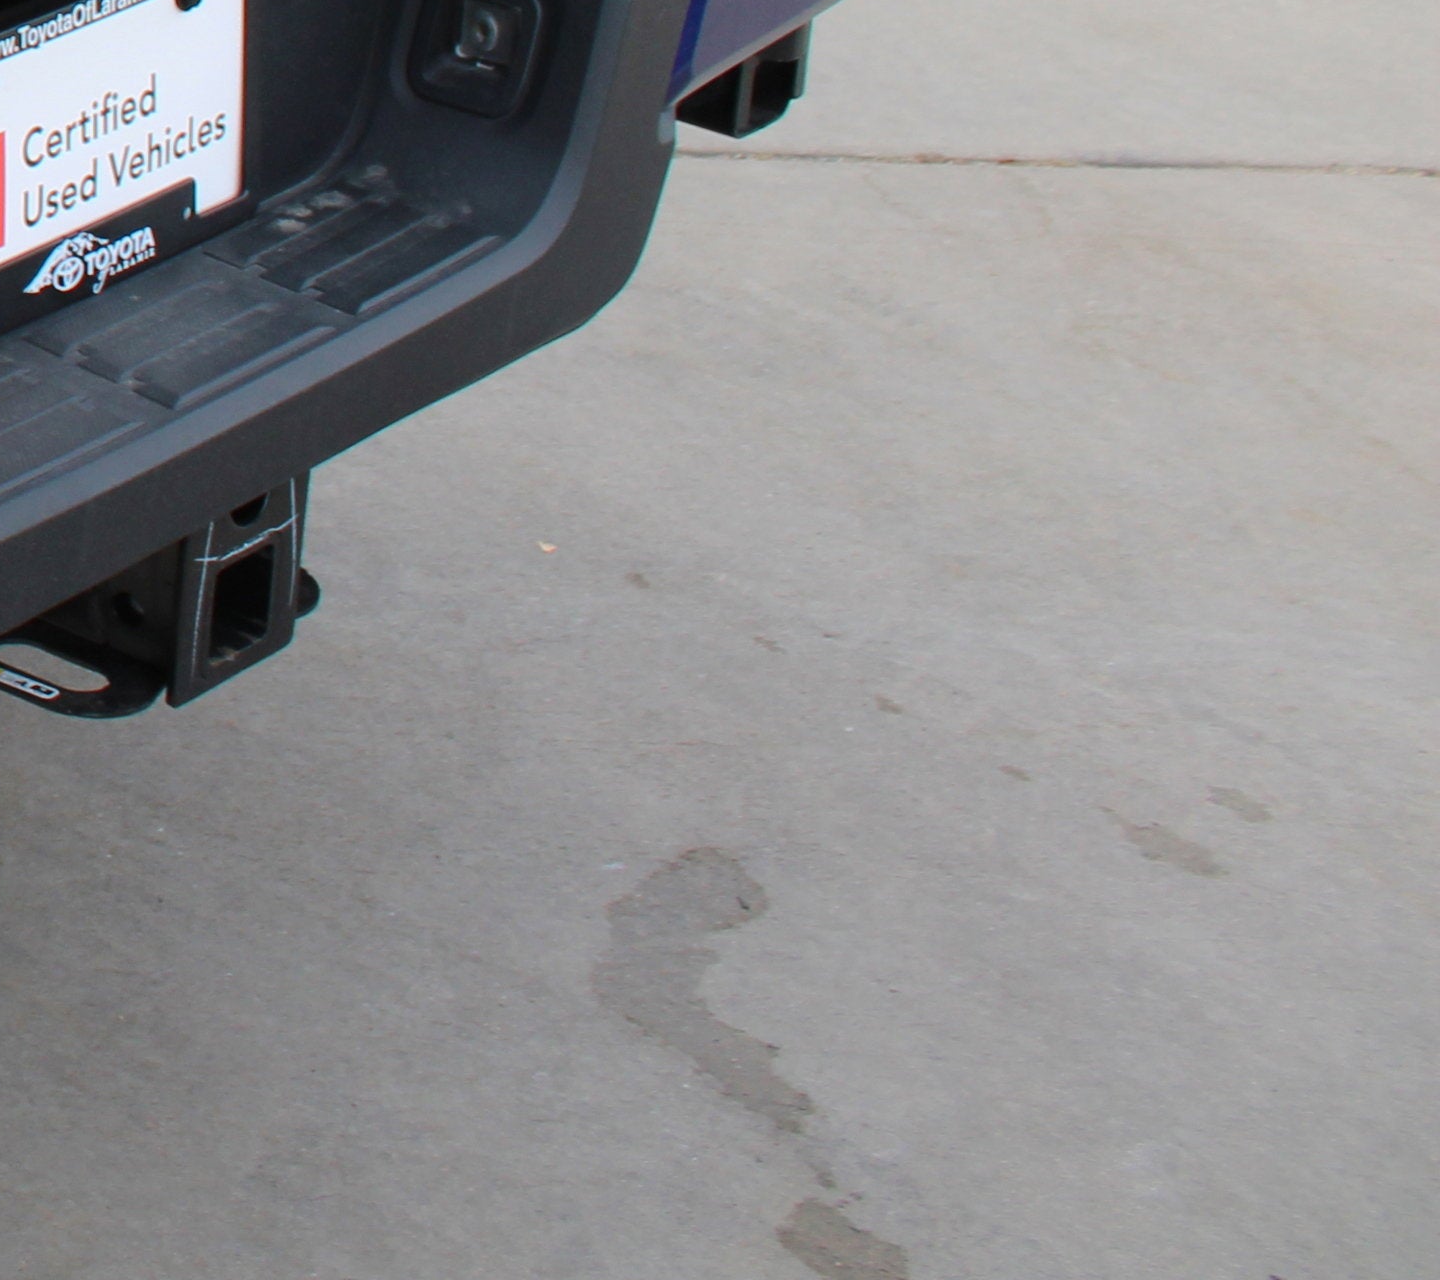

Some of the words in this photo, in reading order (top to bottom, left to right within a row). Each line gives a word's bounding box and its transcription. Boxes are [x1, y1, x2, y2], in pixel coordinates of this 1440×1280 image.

[22, 72, 156, 168] Certified
[23, 157, 98, 228] Used
[108, 112, 226, 188] Vehicles
[83, 226, 156, 276] TOYOTA
[110, 247, 156, 276] LARAMIE
